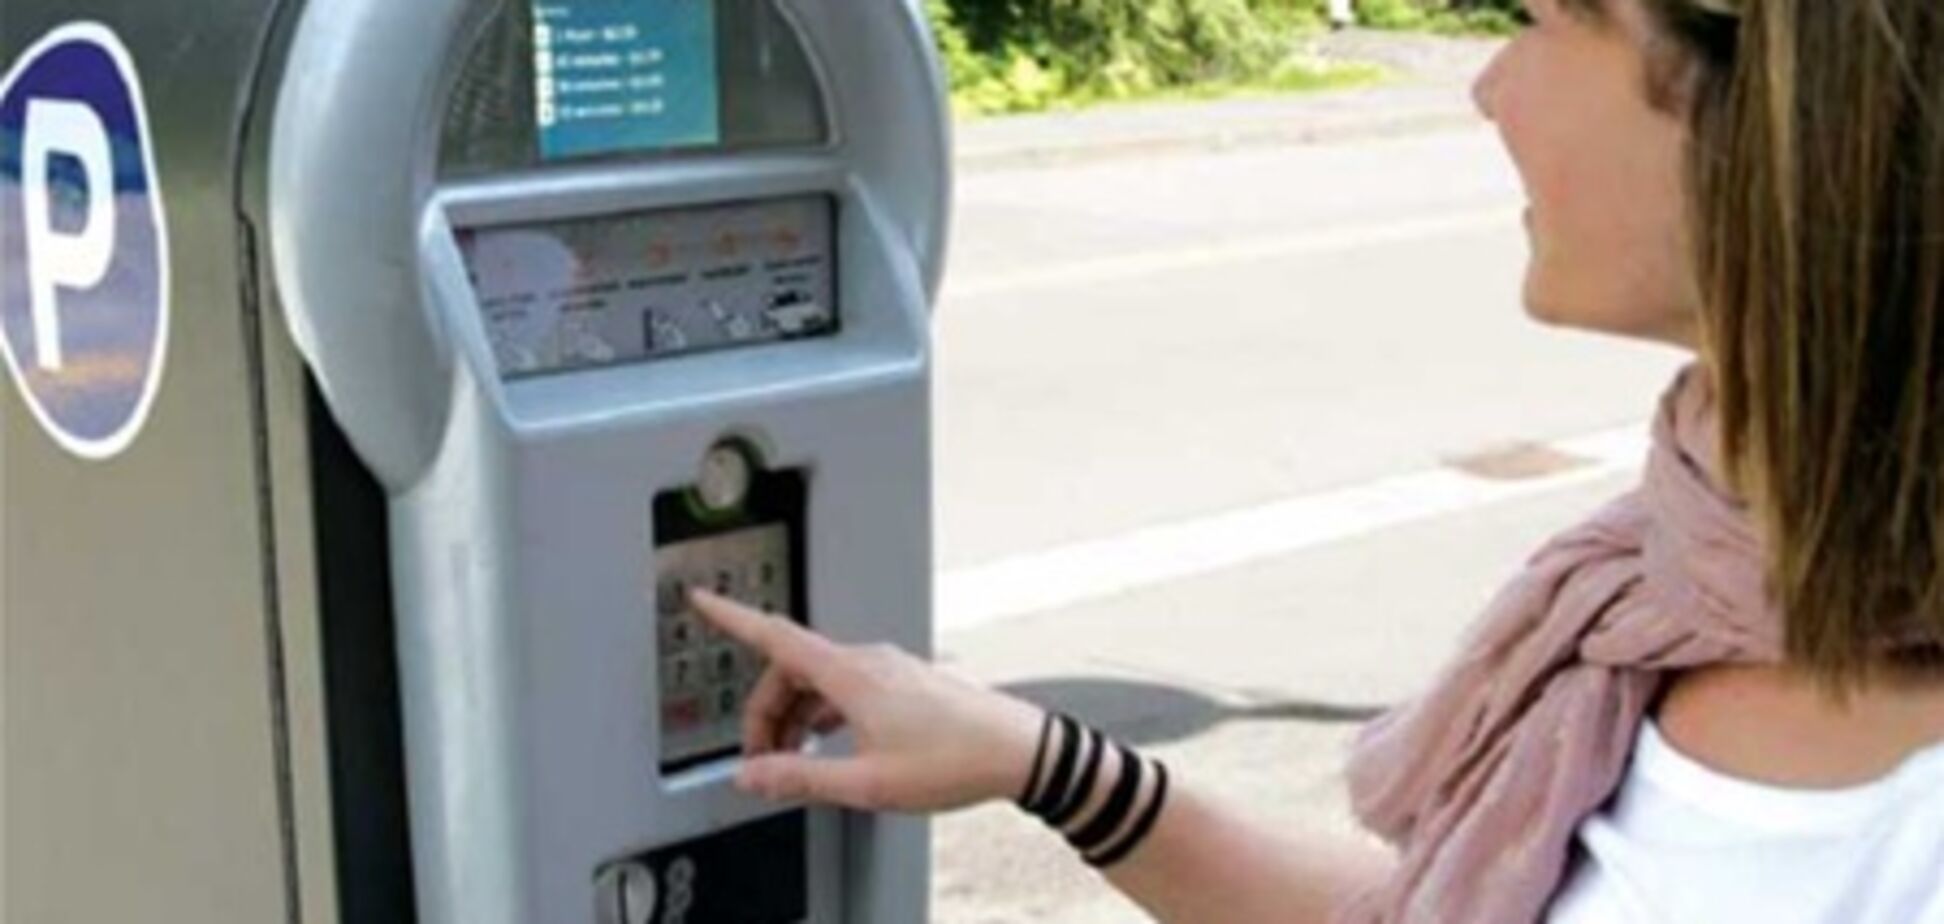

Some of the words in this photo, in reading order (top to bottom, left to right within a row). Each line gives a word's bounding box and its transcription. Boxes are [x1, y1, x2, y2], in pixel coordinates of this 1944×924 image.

[22, 98, 115, 370] P
[716, 569, 731, 597] 2
[674, 622, 688, 642] 4
[677, 658, 689, 685] 7
